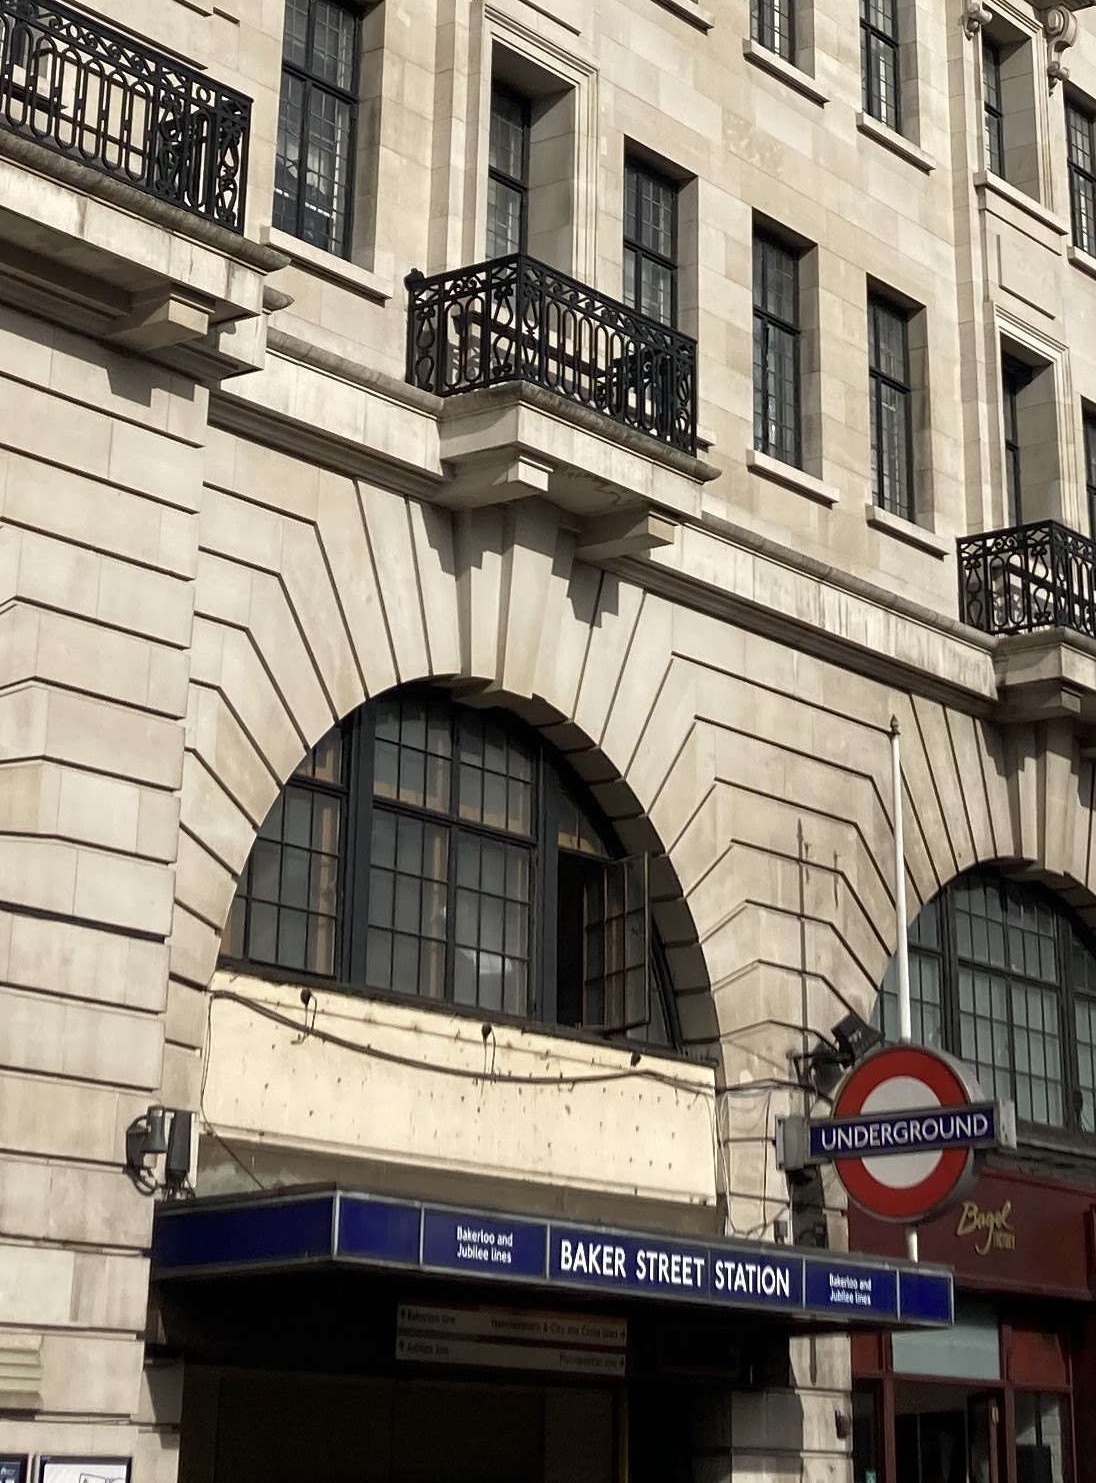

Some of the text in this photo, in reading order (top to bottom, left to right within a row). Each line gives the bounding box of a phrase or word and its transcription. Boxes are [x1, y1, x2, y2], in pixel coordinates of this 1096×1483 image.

[821, 1113, 988, 1151] UNDERGROUND
[457, 1226, 513, 1247] Bakerloo and
[957, 1199, 1014, 1255] Bagel
[457, 1243, 512, 1264] Jubilee lines
[560, 1239, 790, 1297] BAKER STREET STATION
[829, 1273, 872, 1292] Bakerloo and
[830, 1288, 872, 1305] Jubilee lines
